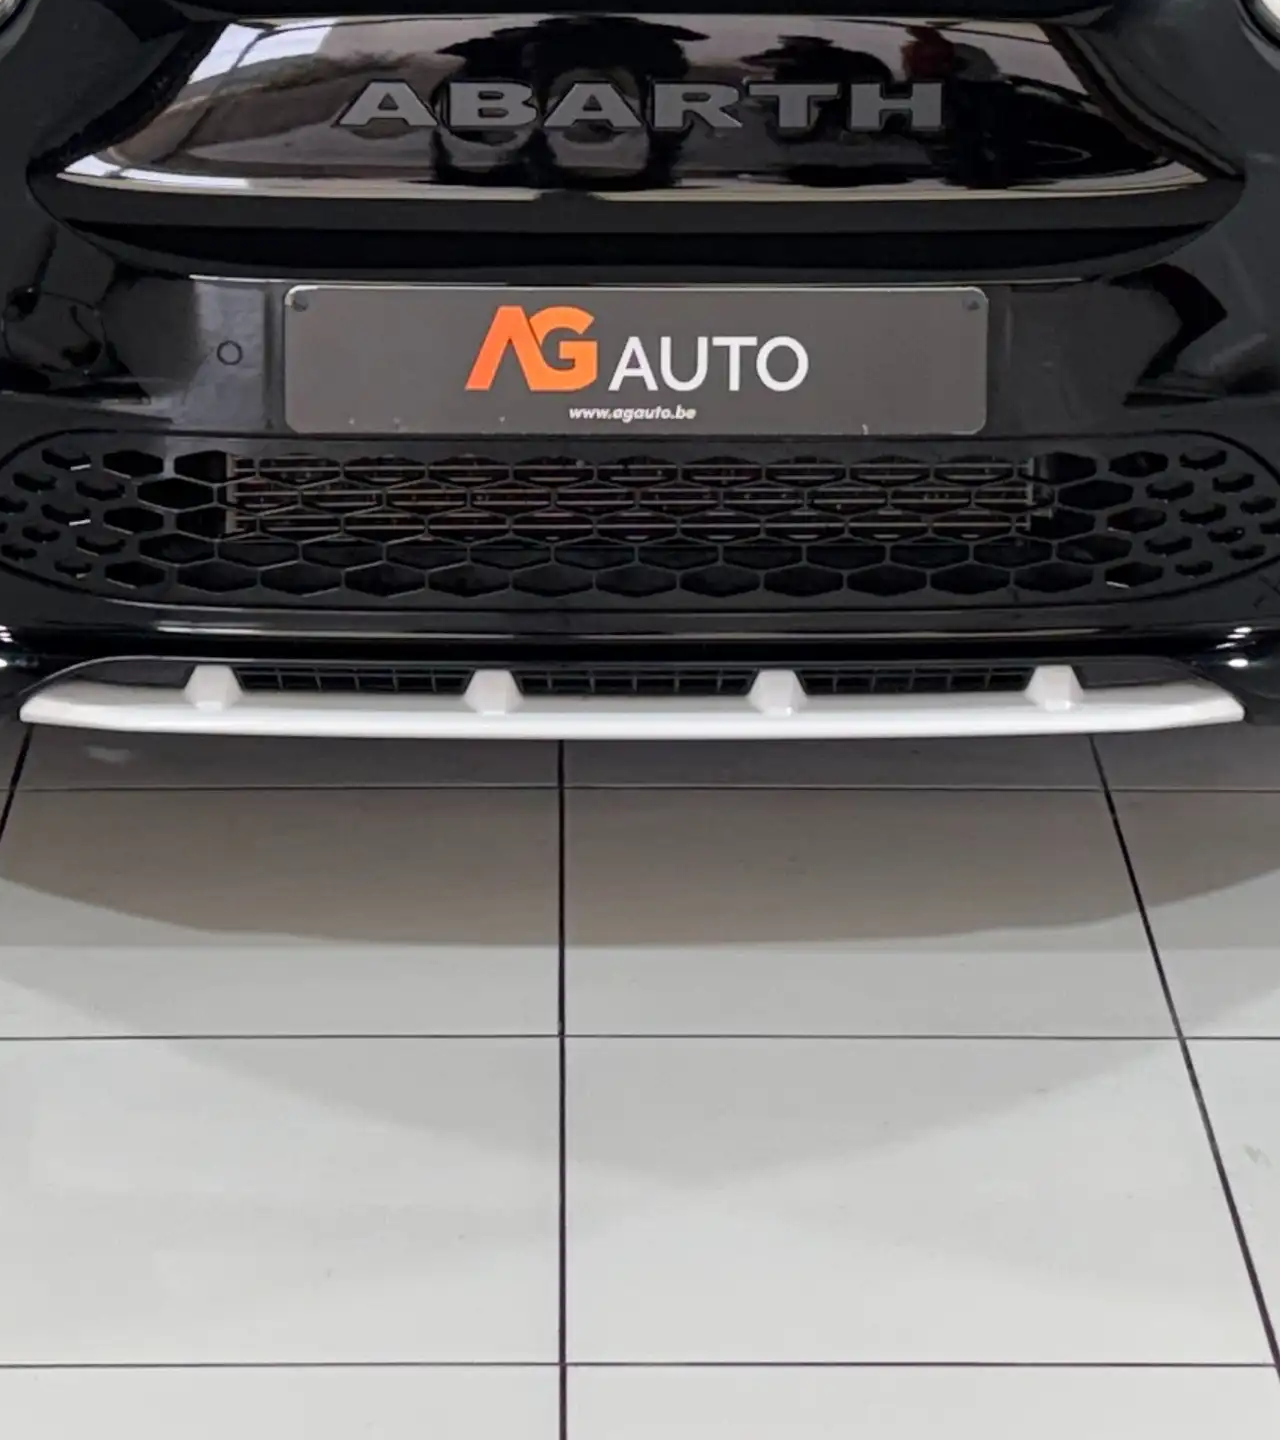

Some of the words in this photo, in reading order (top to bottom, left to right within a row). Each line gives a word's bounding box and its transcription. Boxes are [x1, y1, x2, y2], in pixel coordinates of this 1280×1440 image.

[337, 80, 943, 130] ABARTH
[464, 305, 598, 392] AG
[608, 336, 809, 392] AUTO
[569, 405, 697, 423] www.agauto.be
